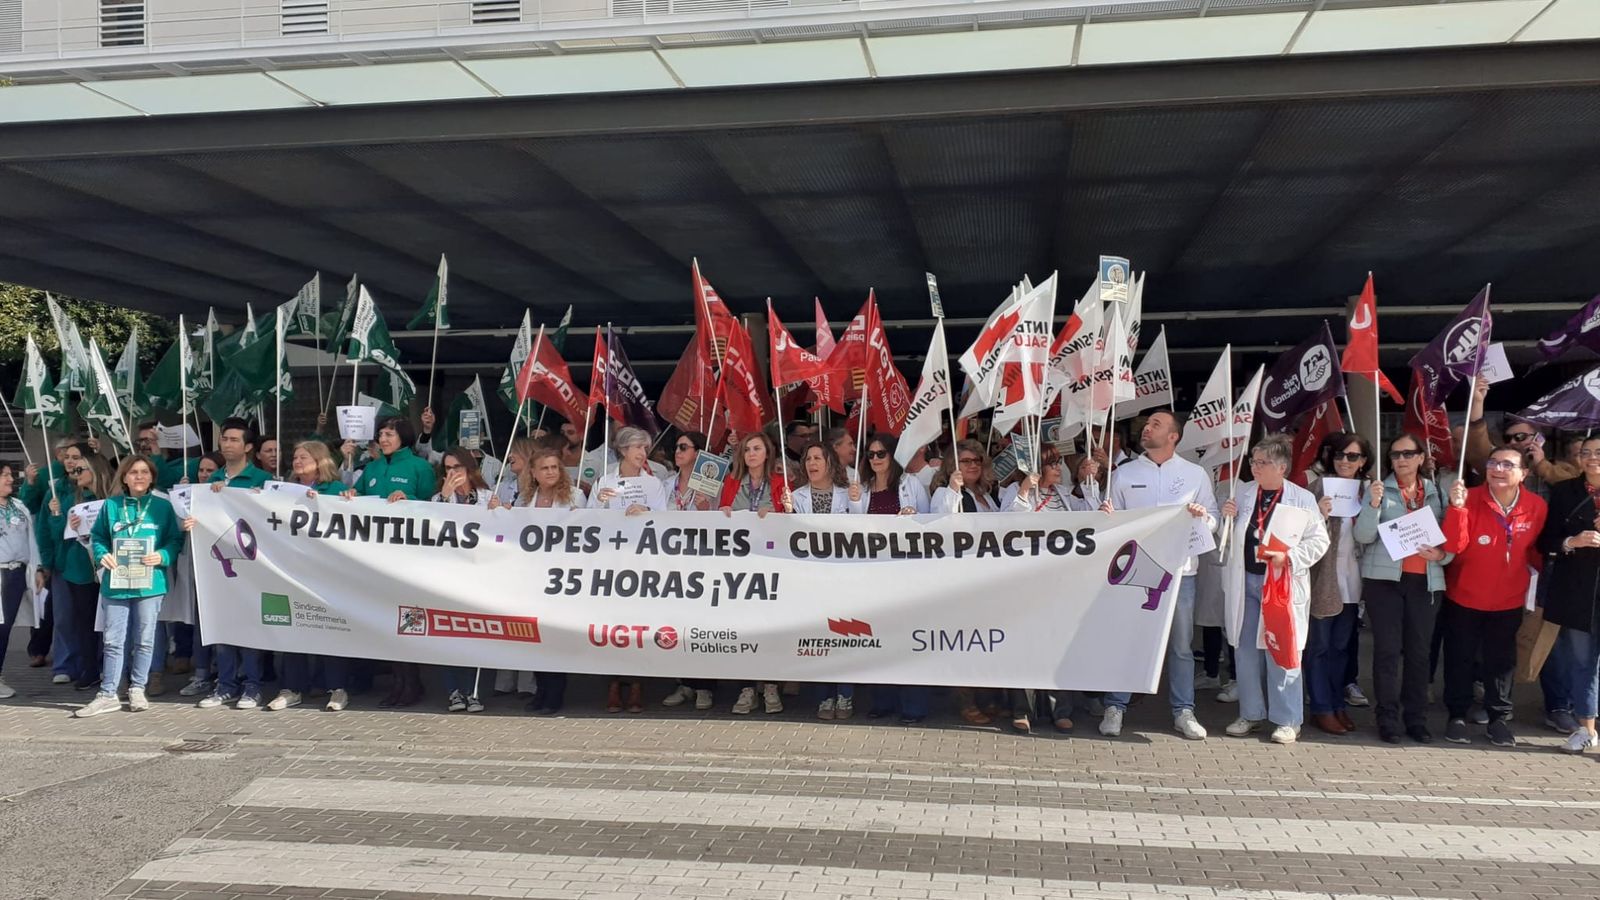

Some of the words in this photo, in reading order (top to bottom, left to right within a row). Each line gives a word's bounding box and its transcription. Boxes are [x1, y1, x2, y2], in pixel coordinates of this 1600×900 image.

[869, 327, 896, 380] UGT
[289, 503, 480, 549] PLANTILLAS
[519, 524, 601, 554] OPES
[635, 519, 751, 557] ÁGILES
[789, 529, 946, 559] CUMPLIR
[951, 527, 1096, 560] PACTOS
[544, 567, 583, 596] 35
[590, 569, 705, 599] HORAS
[711, 572, 779, 607] ¡YA!
[294, 601, 327, 613] Sindicato
[263, 614, 290, 623] SATSE
[295, 612, 305, 620] de
[433, 614, 505, 636] CCOO
[588, 623, 650, 649] UGT
[690, 627, 738, 640] Serveis
[797, 638, 882, 649] INTERSINDICAL
[911, 628, 1006, 653] SIMAP
[690, 642, 738, 654] Públics
[740, 643, 759, 654] PV
[796, 648, 830, 657] SALUT
